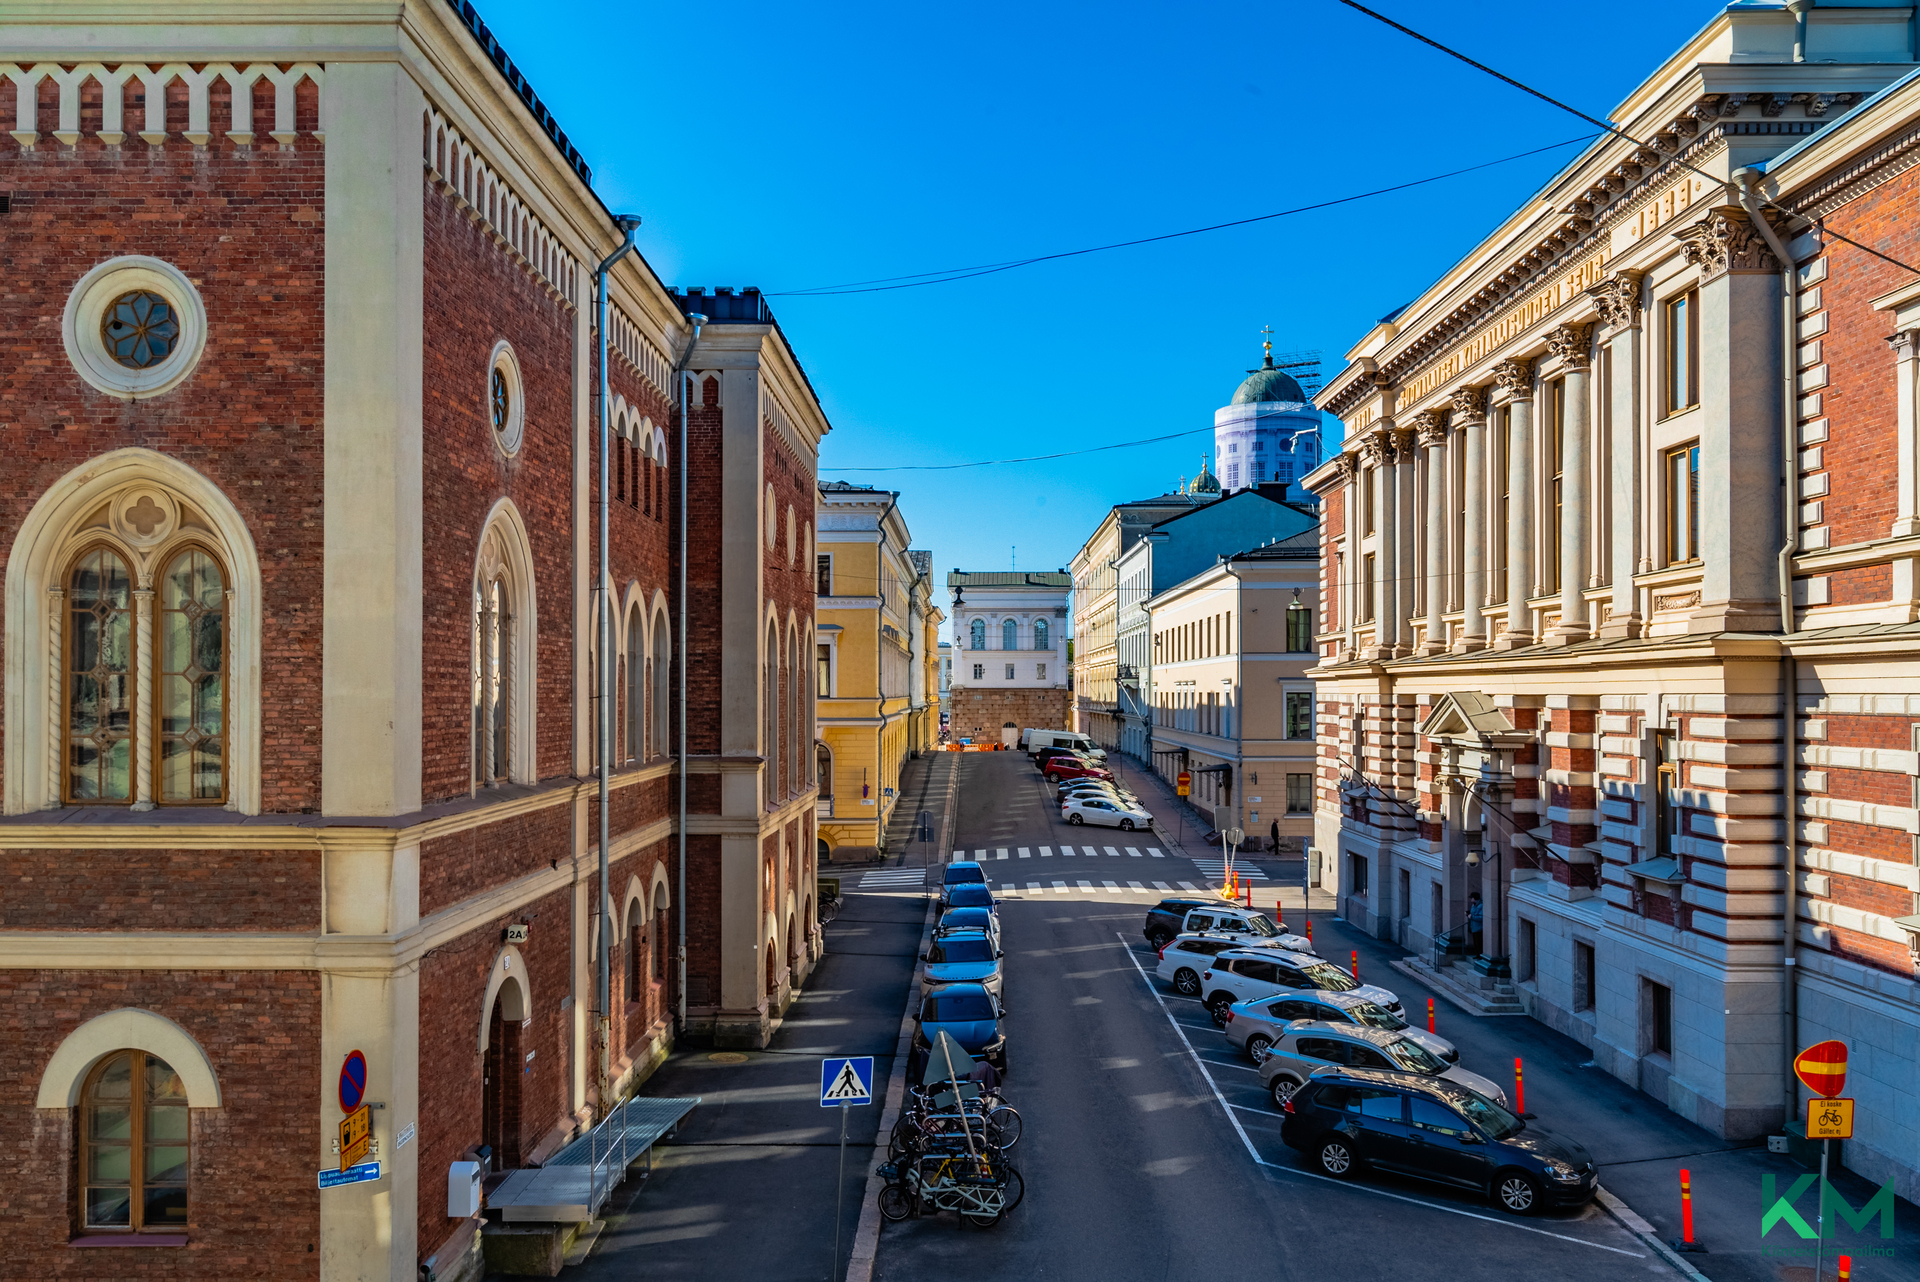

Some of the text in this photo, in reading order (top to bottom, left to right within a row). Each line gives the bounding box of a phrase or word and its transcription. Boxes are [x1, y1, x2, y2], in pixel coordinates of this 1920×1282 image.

[1638, 178, 1692, 239] 1889
[1400, 353, 1460, 410] SUOMALAISEN
[1463, 283, 1561, 368] KIRJALLISUUDEN
[509, 930, 523, 939] 2A
[320, 1166, 363, 1179] Lippuauomaatti
